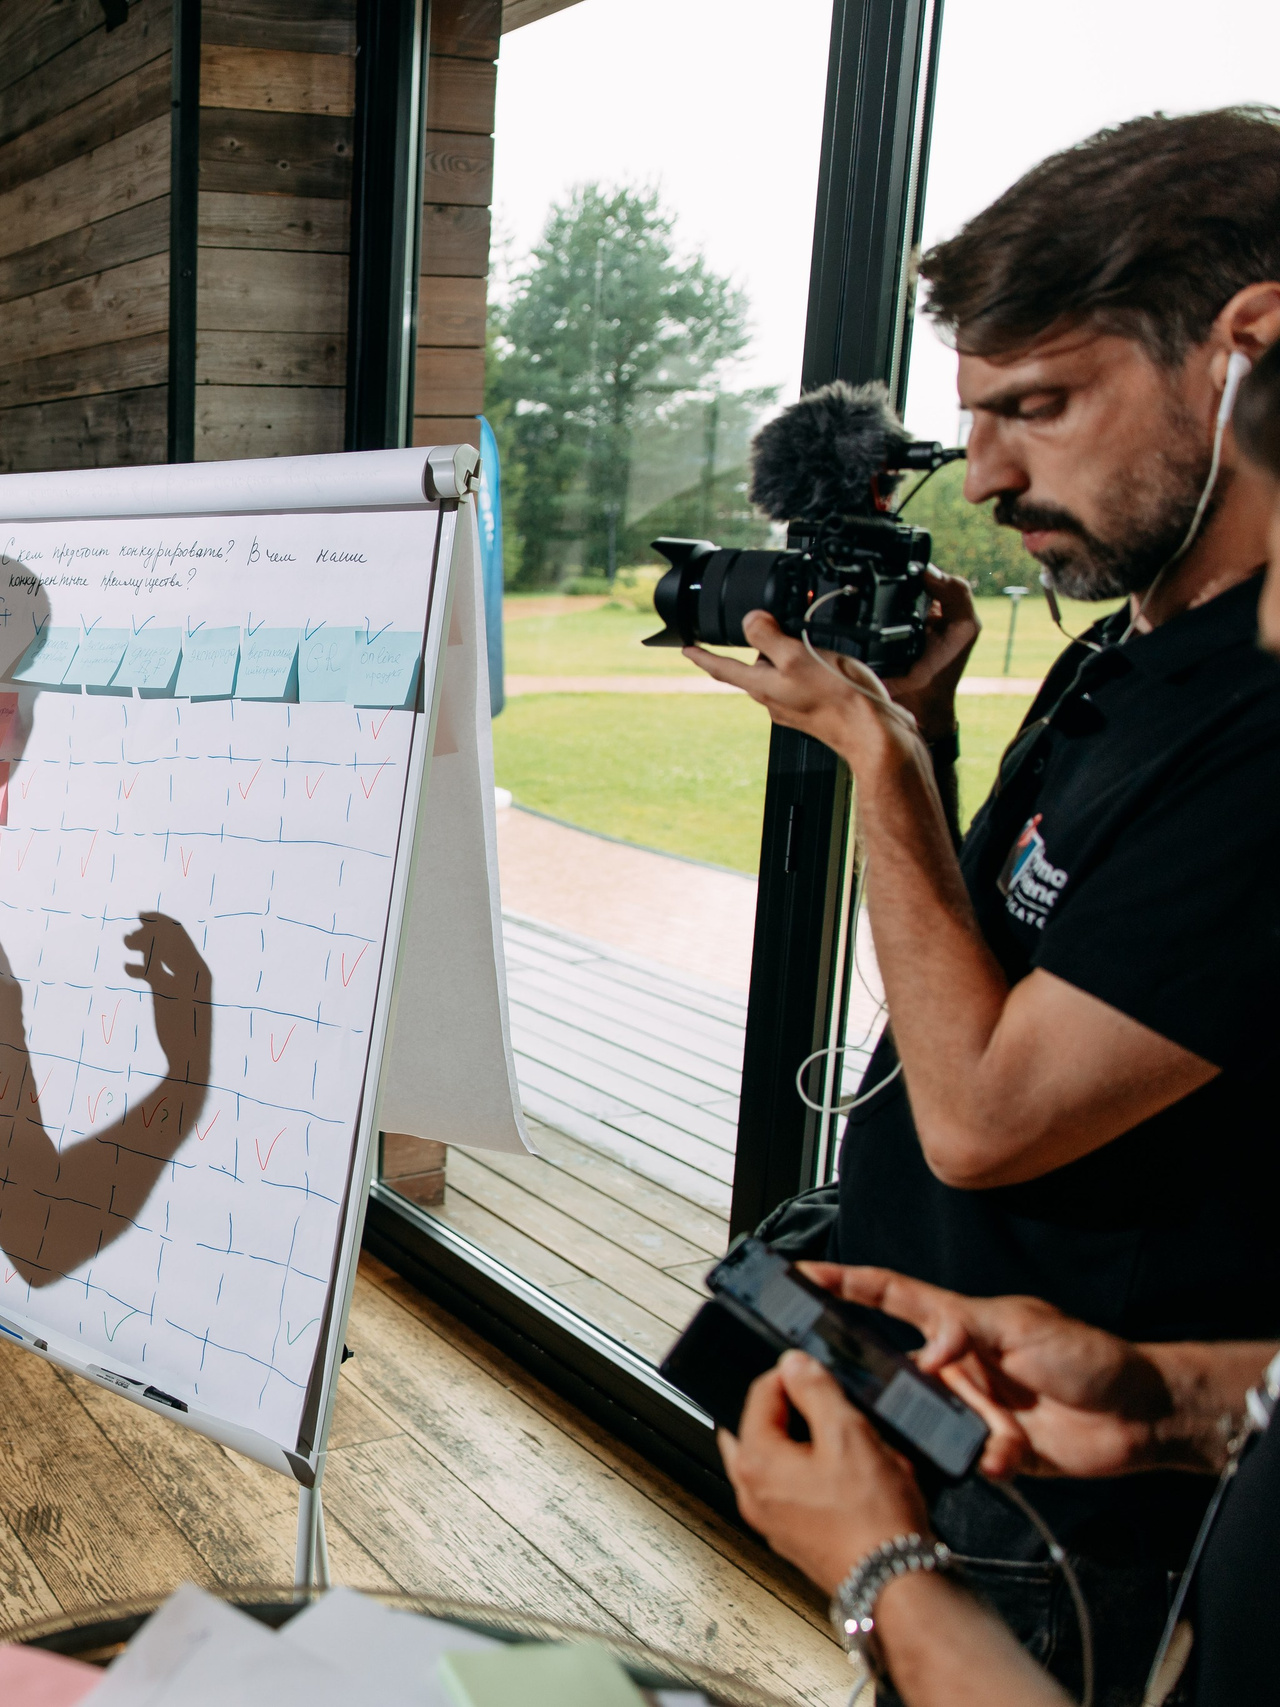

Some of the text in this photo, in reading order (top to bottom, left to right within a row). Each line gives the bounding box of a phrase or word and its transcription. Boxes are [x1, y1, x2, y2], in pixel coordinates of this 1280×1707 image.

[16, 548, 43, 563] кем
[52, 543, 110, 567] предстоит
[118, 540, 235, 572] конкурировать?
[246, 536, 261, 566] В
[266, 548, 297, 563] чем
[8, 567, 197, 597] конкурентные преимущества?
